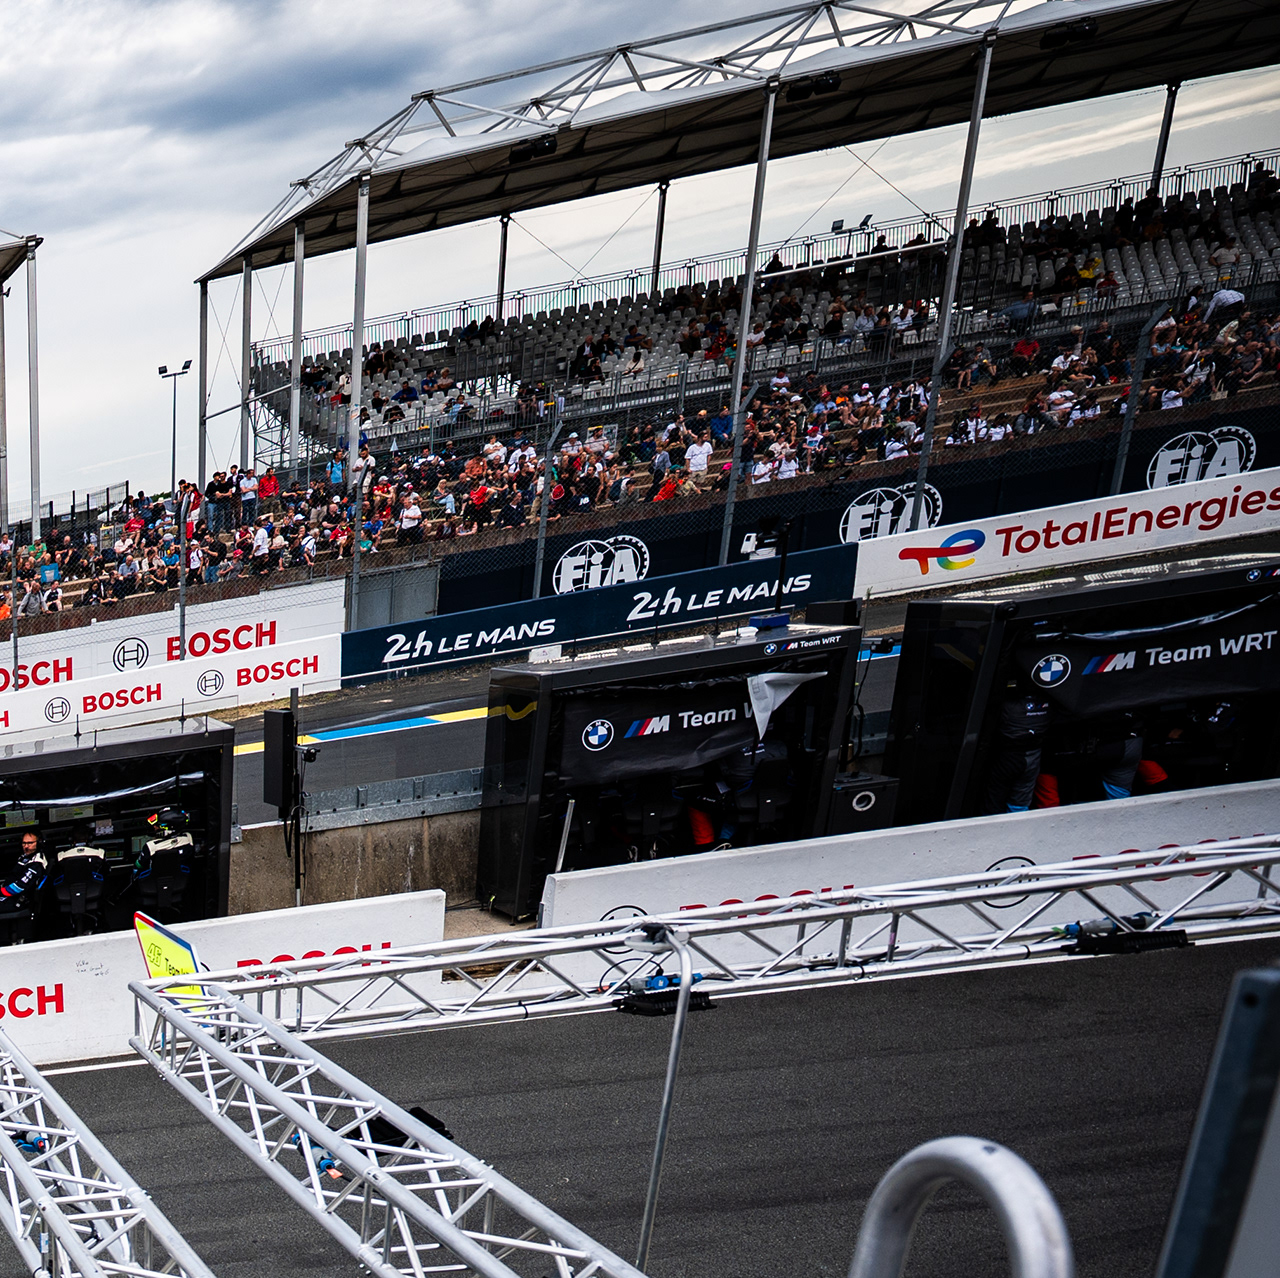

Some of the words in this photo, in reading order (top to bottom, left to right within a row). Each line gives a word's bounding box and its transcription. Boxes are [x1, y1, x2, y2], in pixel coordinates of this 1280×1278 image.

[995, 484, 1280, 557] TotalEnergies
[627, 587, 682, 621] 24h
[687, 592, 722, 611] LE
[727, 574, 812, 605] MANS
[167, 620, 277, 661] BOSCH
[383, 630, 432, 663] 24h
[437, 633, 473, 653] LE
[477, 618, 556, 647] MANS
[800, 640, 820, 648] Team
[822, 635, 841, 644] WRT
[1145, 644, 1211, 667] Team
[1220, 630, 1278, 656] WRT
[237, 655, 319, 687] BOSCH
[83, 683, 162, 714] BOSCH
[678, 706, 737, 729] Team
